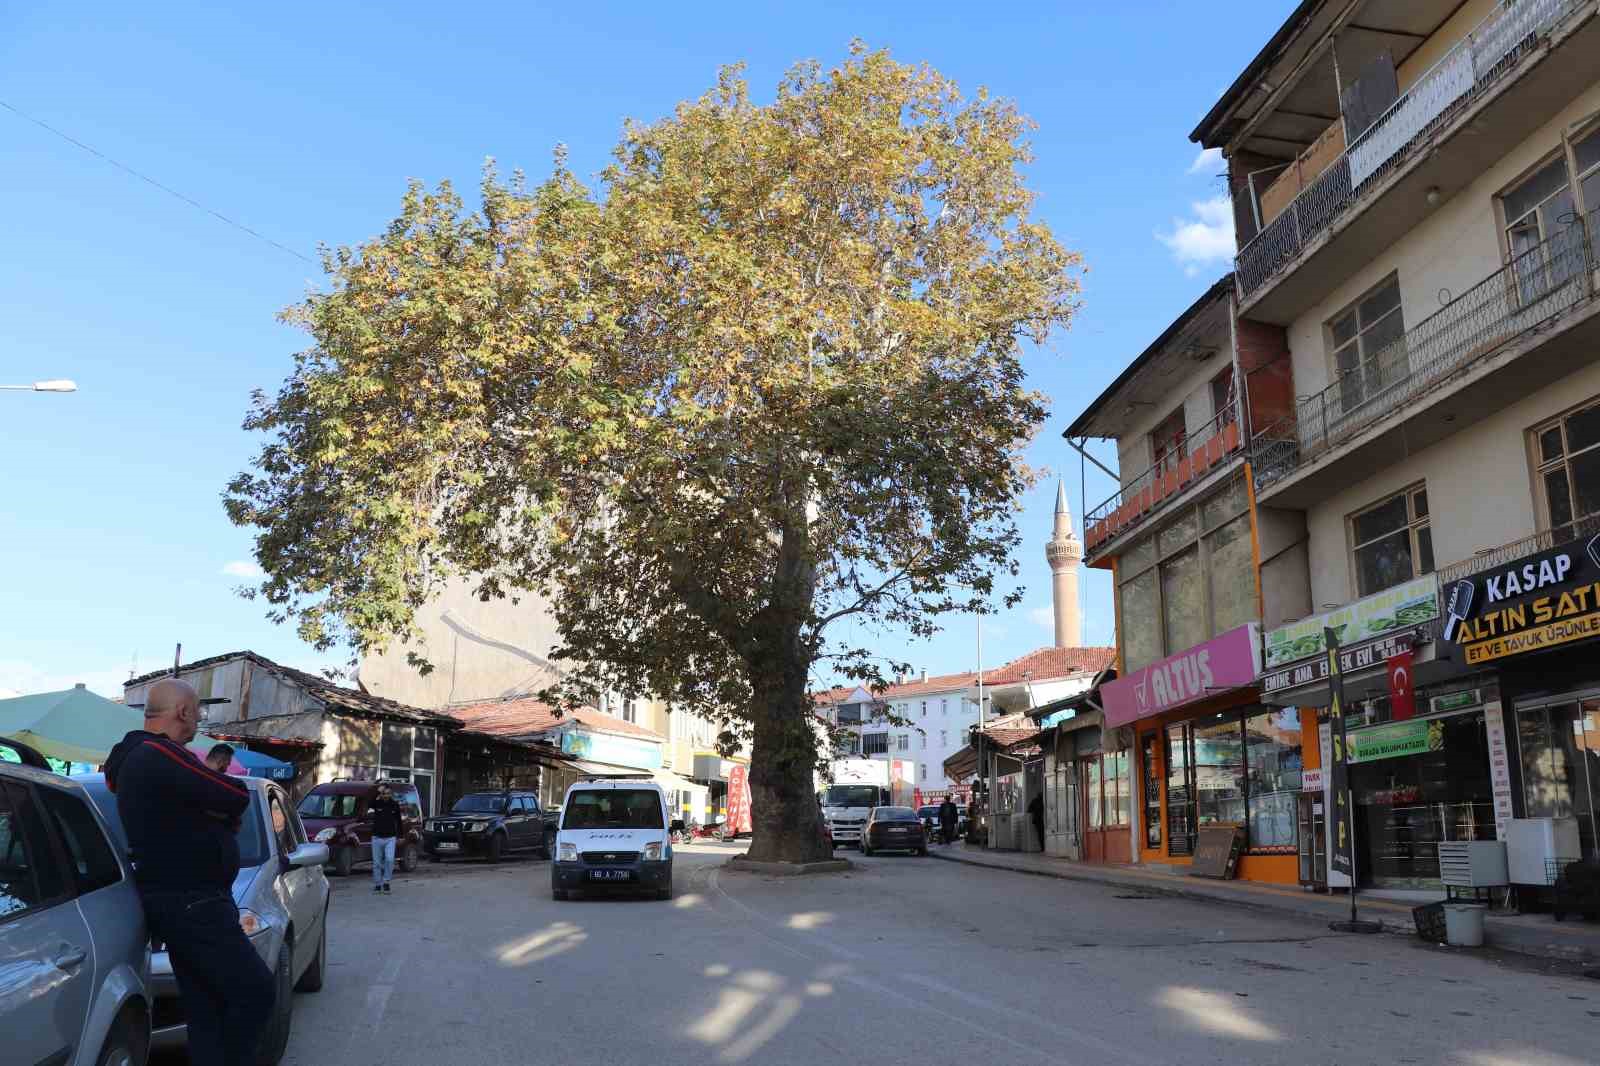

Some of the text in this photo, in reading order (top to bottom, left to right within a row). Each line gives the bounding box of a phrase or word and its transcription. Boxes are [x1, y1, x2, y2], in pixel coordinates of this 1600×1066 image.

[1486, 554, 1571, 603] KASAP
[1456, 603, 1526, 645] ALTIN
[1470, 615, 1600, 660] ET VE TAVUK ÜRÜNLE
[1152, 649, 1213, 707] ALTUS
[1295, 664, 1313, 683] ANA
